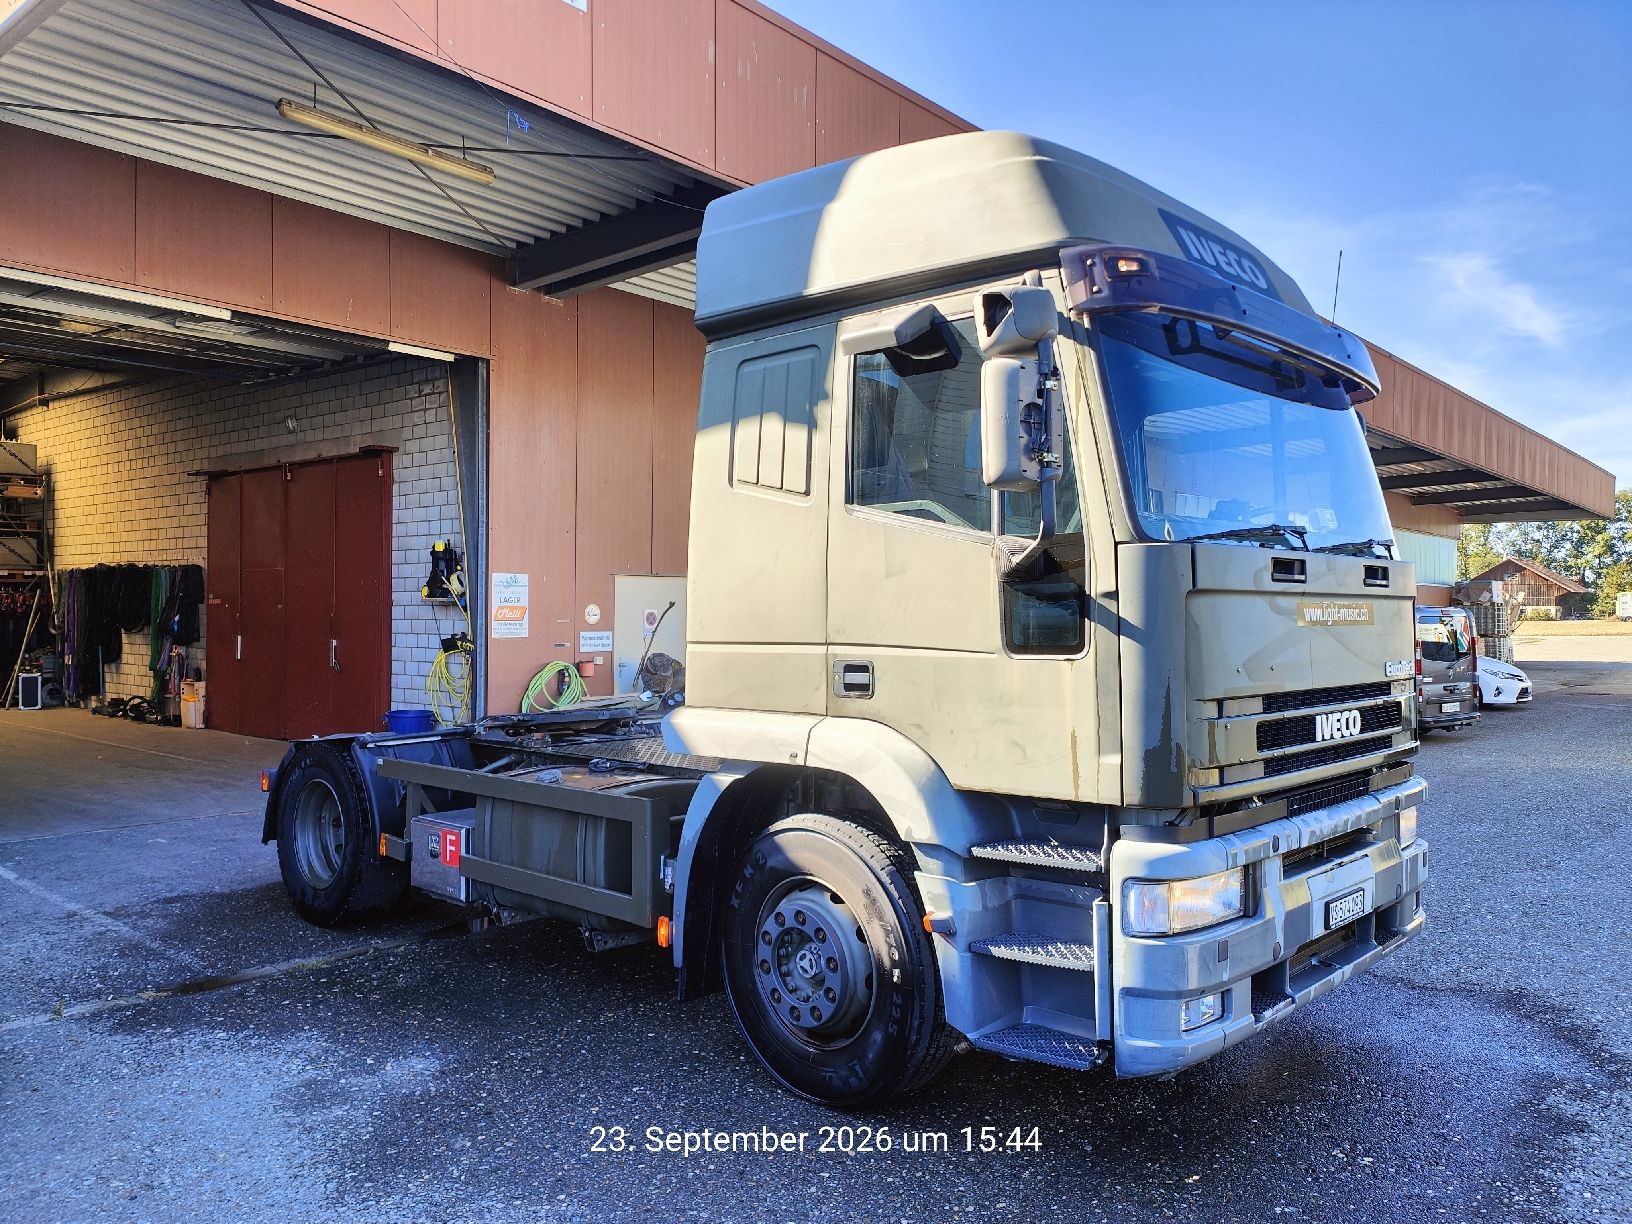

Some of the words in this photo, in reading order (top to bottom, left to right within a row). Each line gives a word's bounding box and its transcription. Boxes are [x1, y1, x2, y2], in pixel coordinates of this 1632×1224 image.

[1176, 225, 1267, 290] IVECO
[499, 596, 521, 604] LAGER
[1303, 603, 1370, 626] www.light-music.ch
[1315, 709, 1361, 742] IVECO
[446, 834, 456, 862] F
